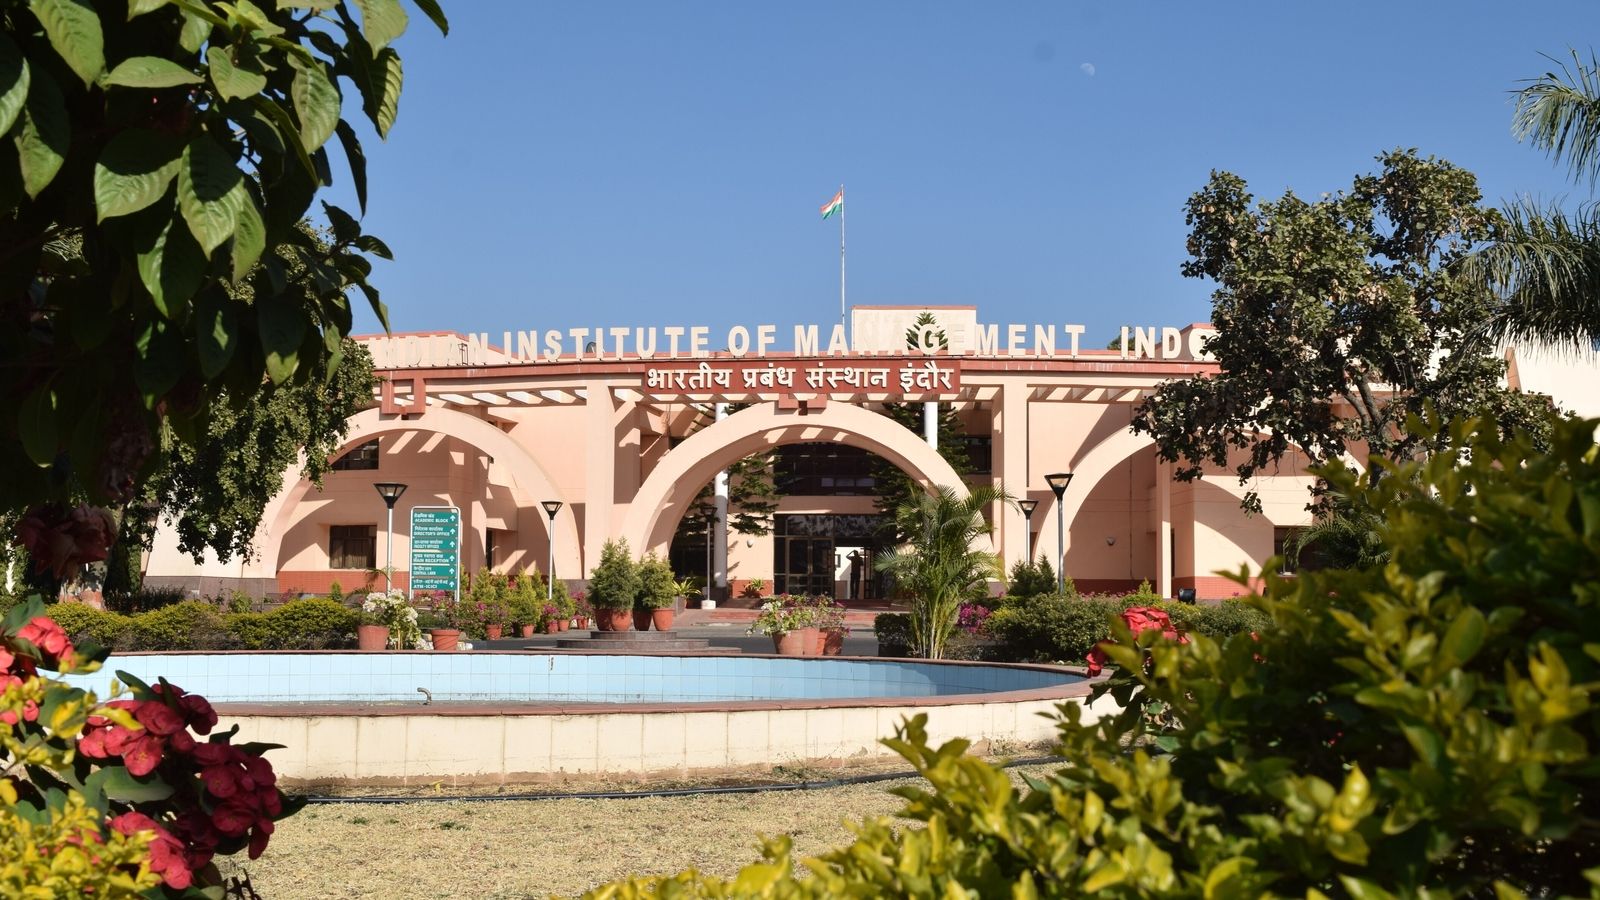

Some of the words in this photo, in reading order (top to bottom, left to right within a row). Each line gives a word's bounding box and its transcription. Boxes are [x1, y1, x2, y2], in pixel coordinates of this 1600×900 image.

[503, 325, 709, 362] INSTITUTE
[727, 325, 776, 357] OF
[794, 323, 1085, 357] MANAGEMENT
[1121, 325, 1213, 361] INDO
[647, 362, 733, 389] भारतीय
[742, 362, 796, 389] प्रबंध
[805, 361, 890, 389] संस्थान
[900, 360, 954, 392] इंदौर
